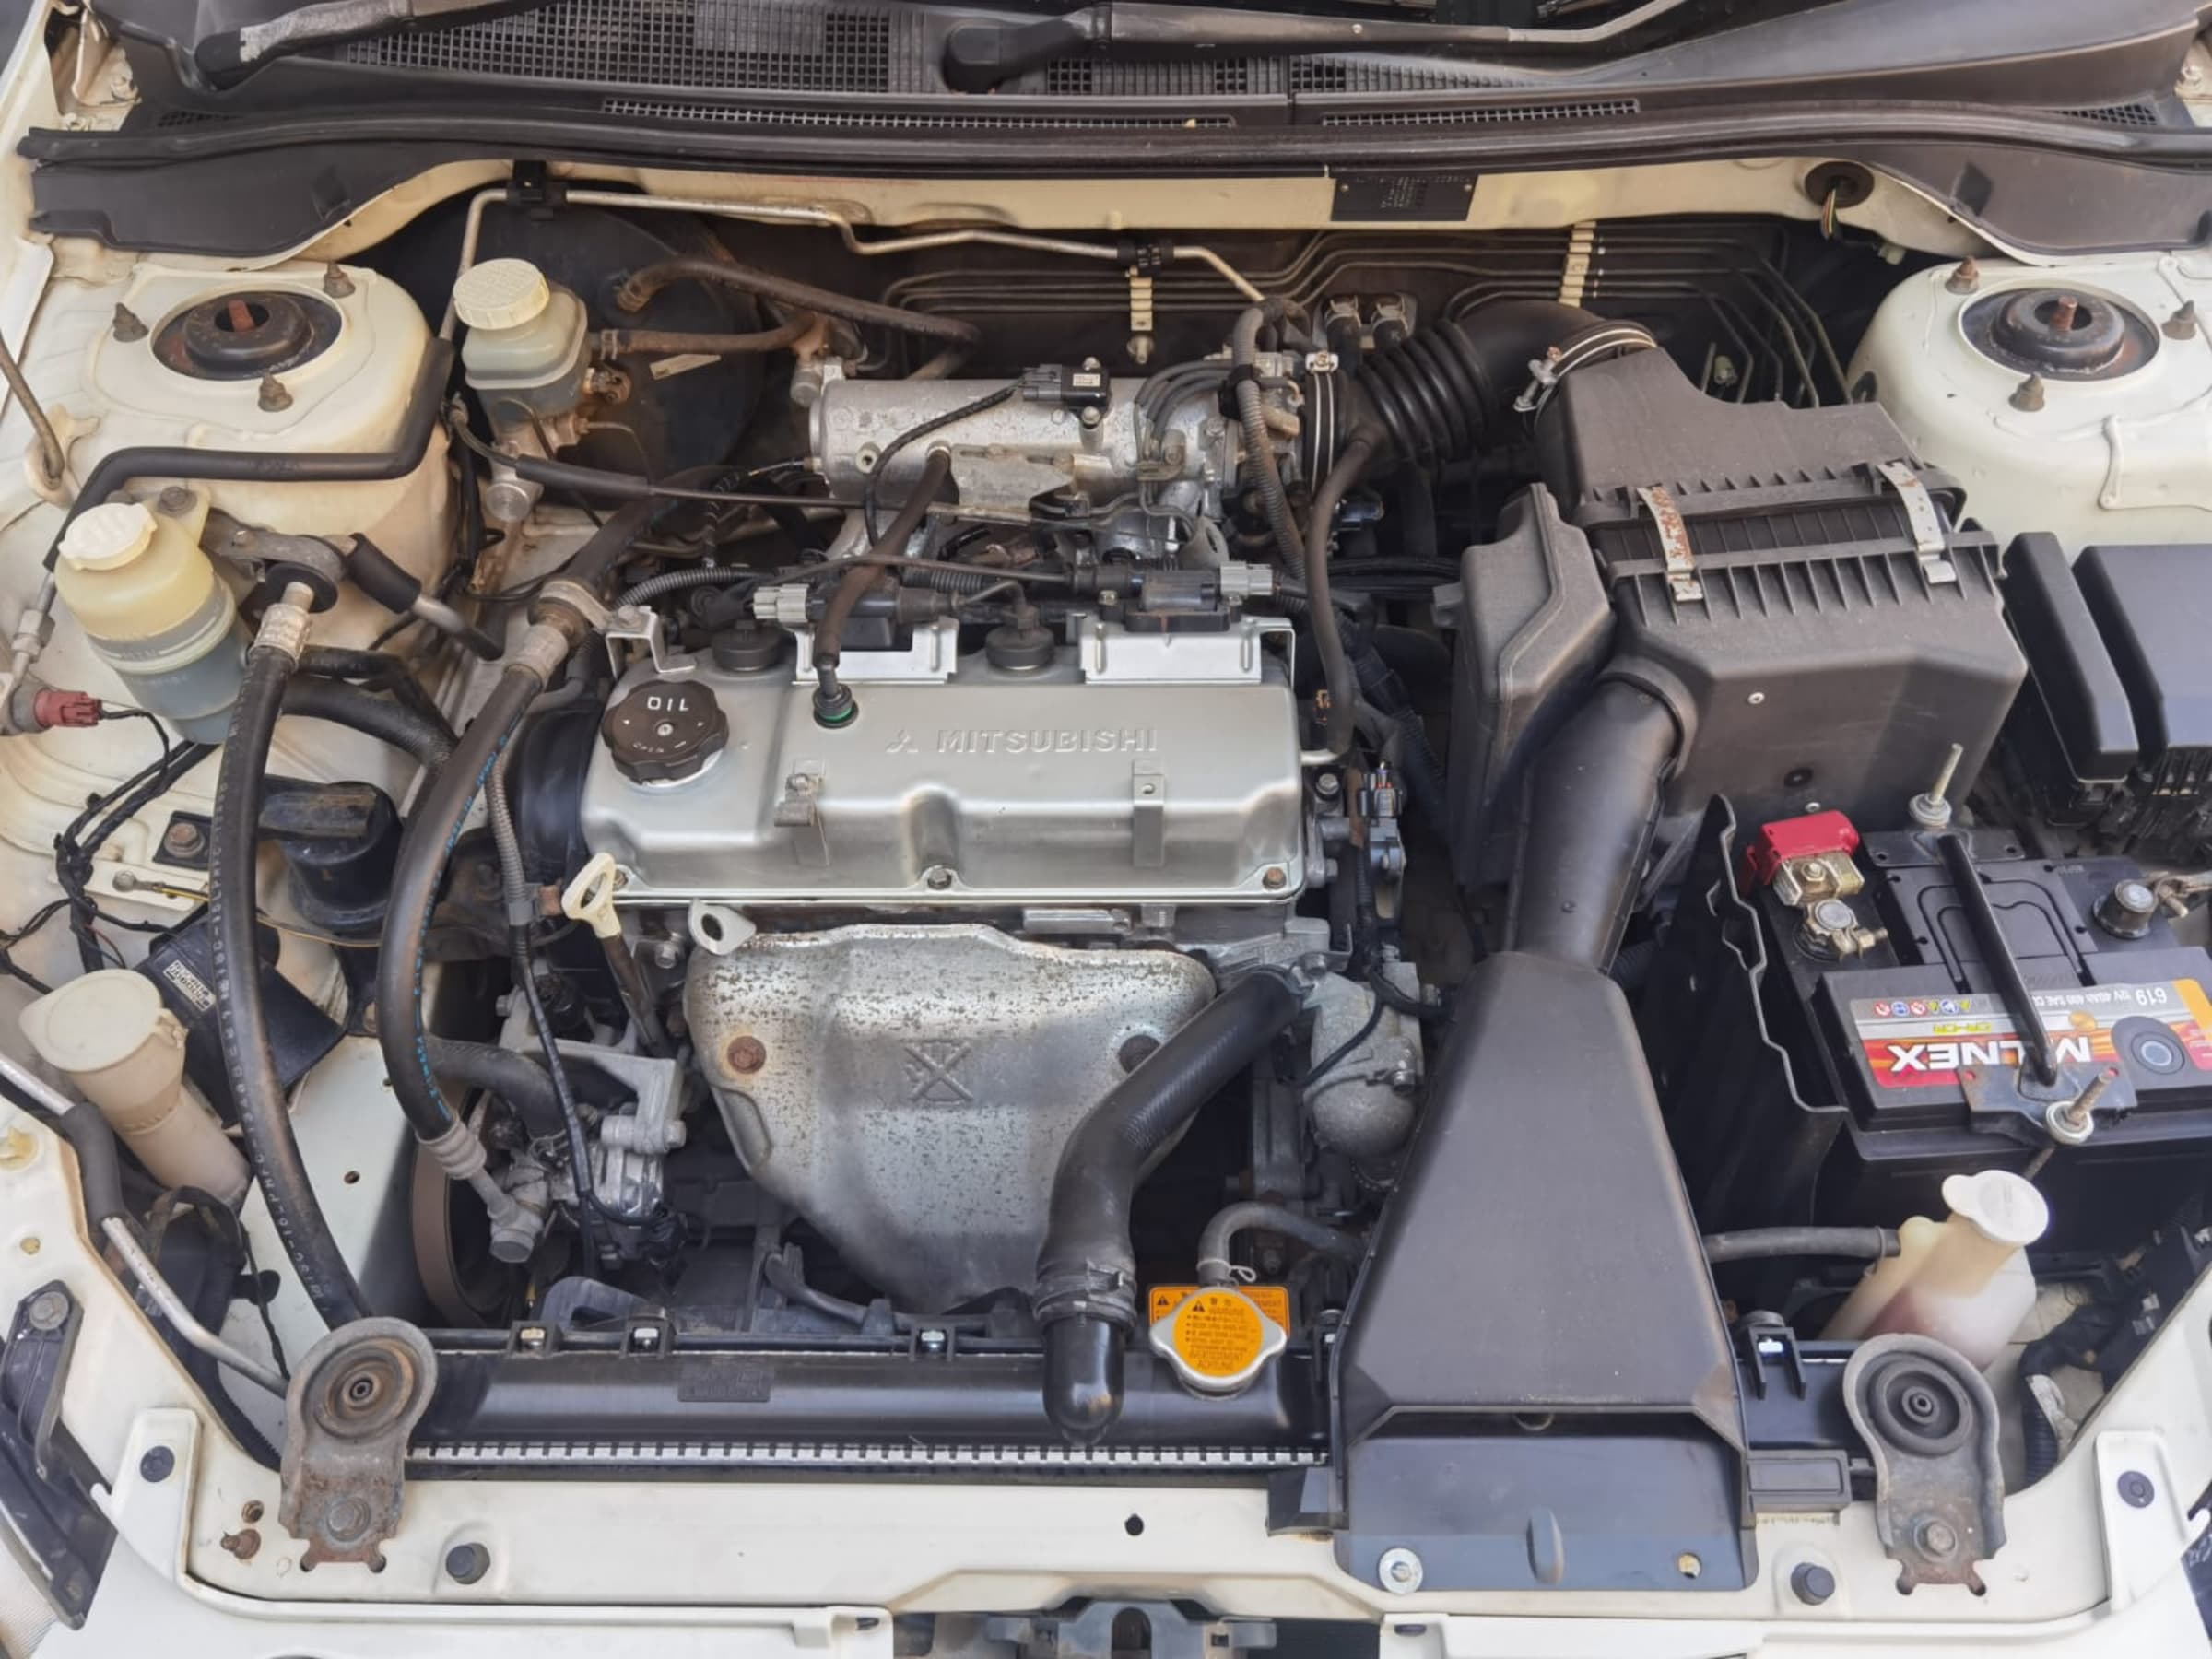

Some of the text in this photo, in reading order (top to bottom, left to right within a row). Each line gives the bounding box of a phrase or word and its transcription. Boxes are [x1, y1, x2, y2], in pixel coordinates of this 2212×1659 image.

[647, 696, 689, 712] OIL
[936, 728, 1159, 754] MITSUBISHI
[2136, 987, 2168, 1006] 619
[1888, 1036, 2092, 1073] MLNEX
